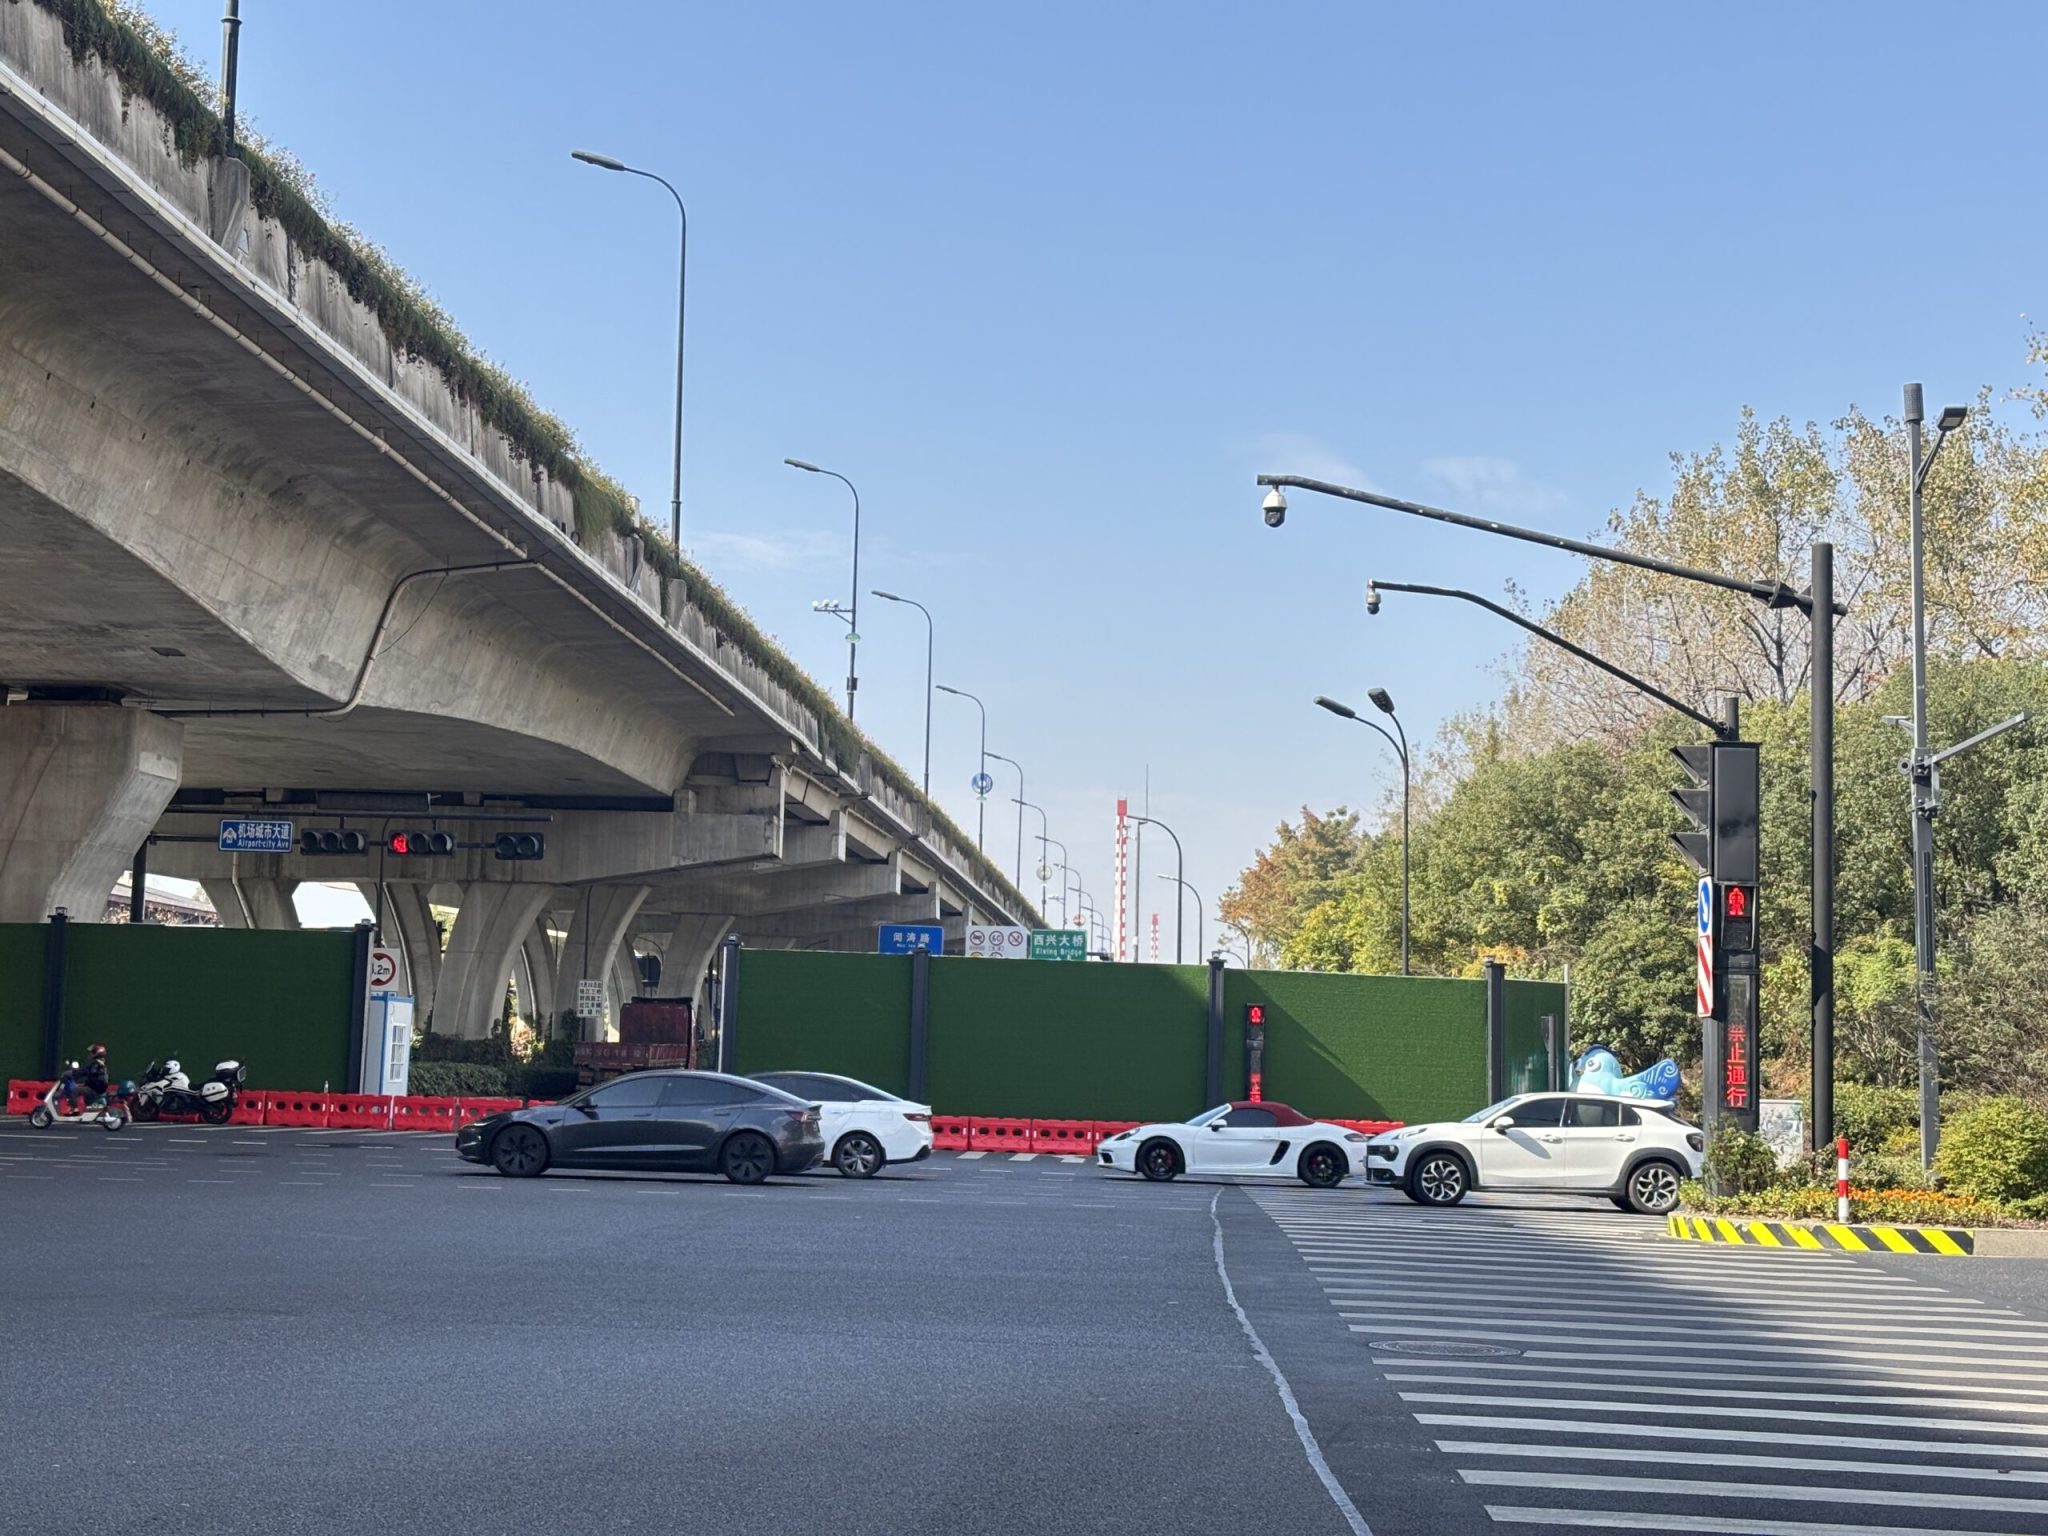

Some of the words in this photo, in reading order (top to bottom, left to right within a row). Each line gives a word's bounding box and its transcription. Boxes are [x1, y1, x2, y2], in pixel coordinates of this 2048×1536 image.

[237, 823, 289, 839] 机场城市大道
[276, 840, 289, 849] Ave
[1033, 934, 1083, 947] 西兴大桥
[1727, 1023, 1746, 1107] 禁止通行
